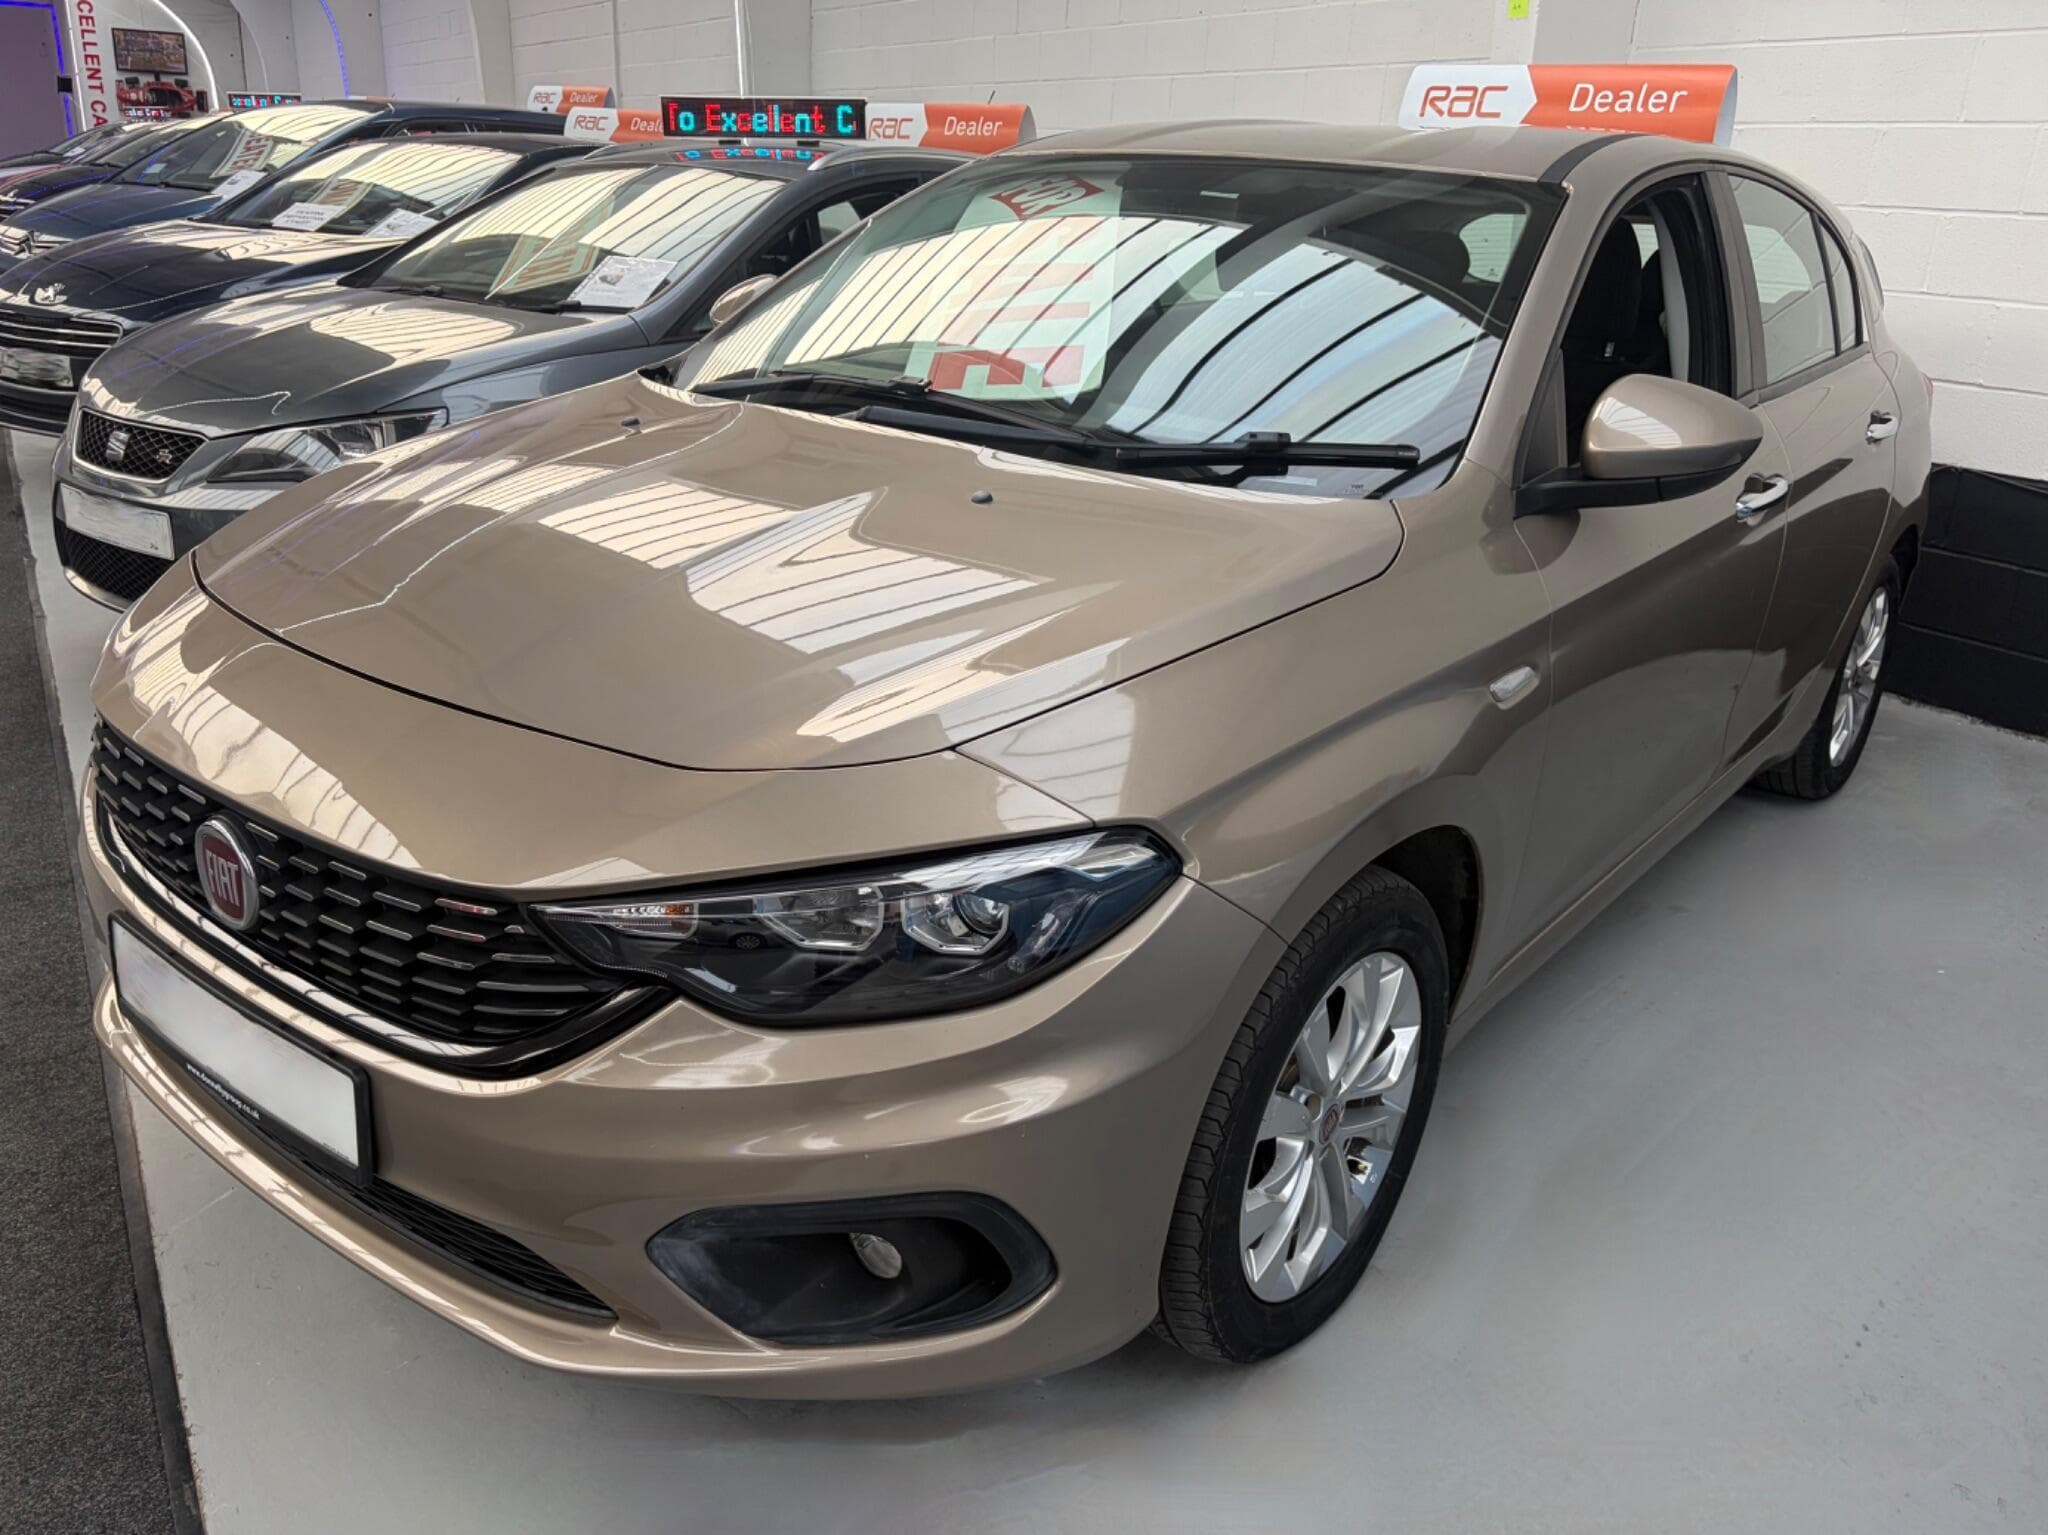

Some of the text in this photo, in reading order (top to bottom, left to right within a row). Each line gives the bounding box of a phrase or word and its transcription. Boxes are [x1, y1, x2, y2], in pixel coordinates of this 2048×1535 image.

[77, 0, 105, 94] CELLENT
[569, 91, 599, 103] Dealer
[1419, 82, 1689, 118] RAC Dealer
[573, 114, 609, 131] RAC
[668, 103, 857, 133] To Excellent C
[868, 116, 1003, 139] RAC Dealer
[205, 849, 239, 907] FIAT
